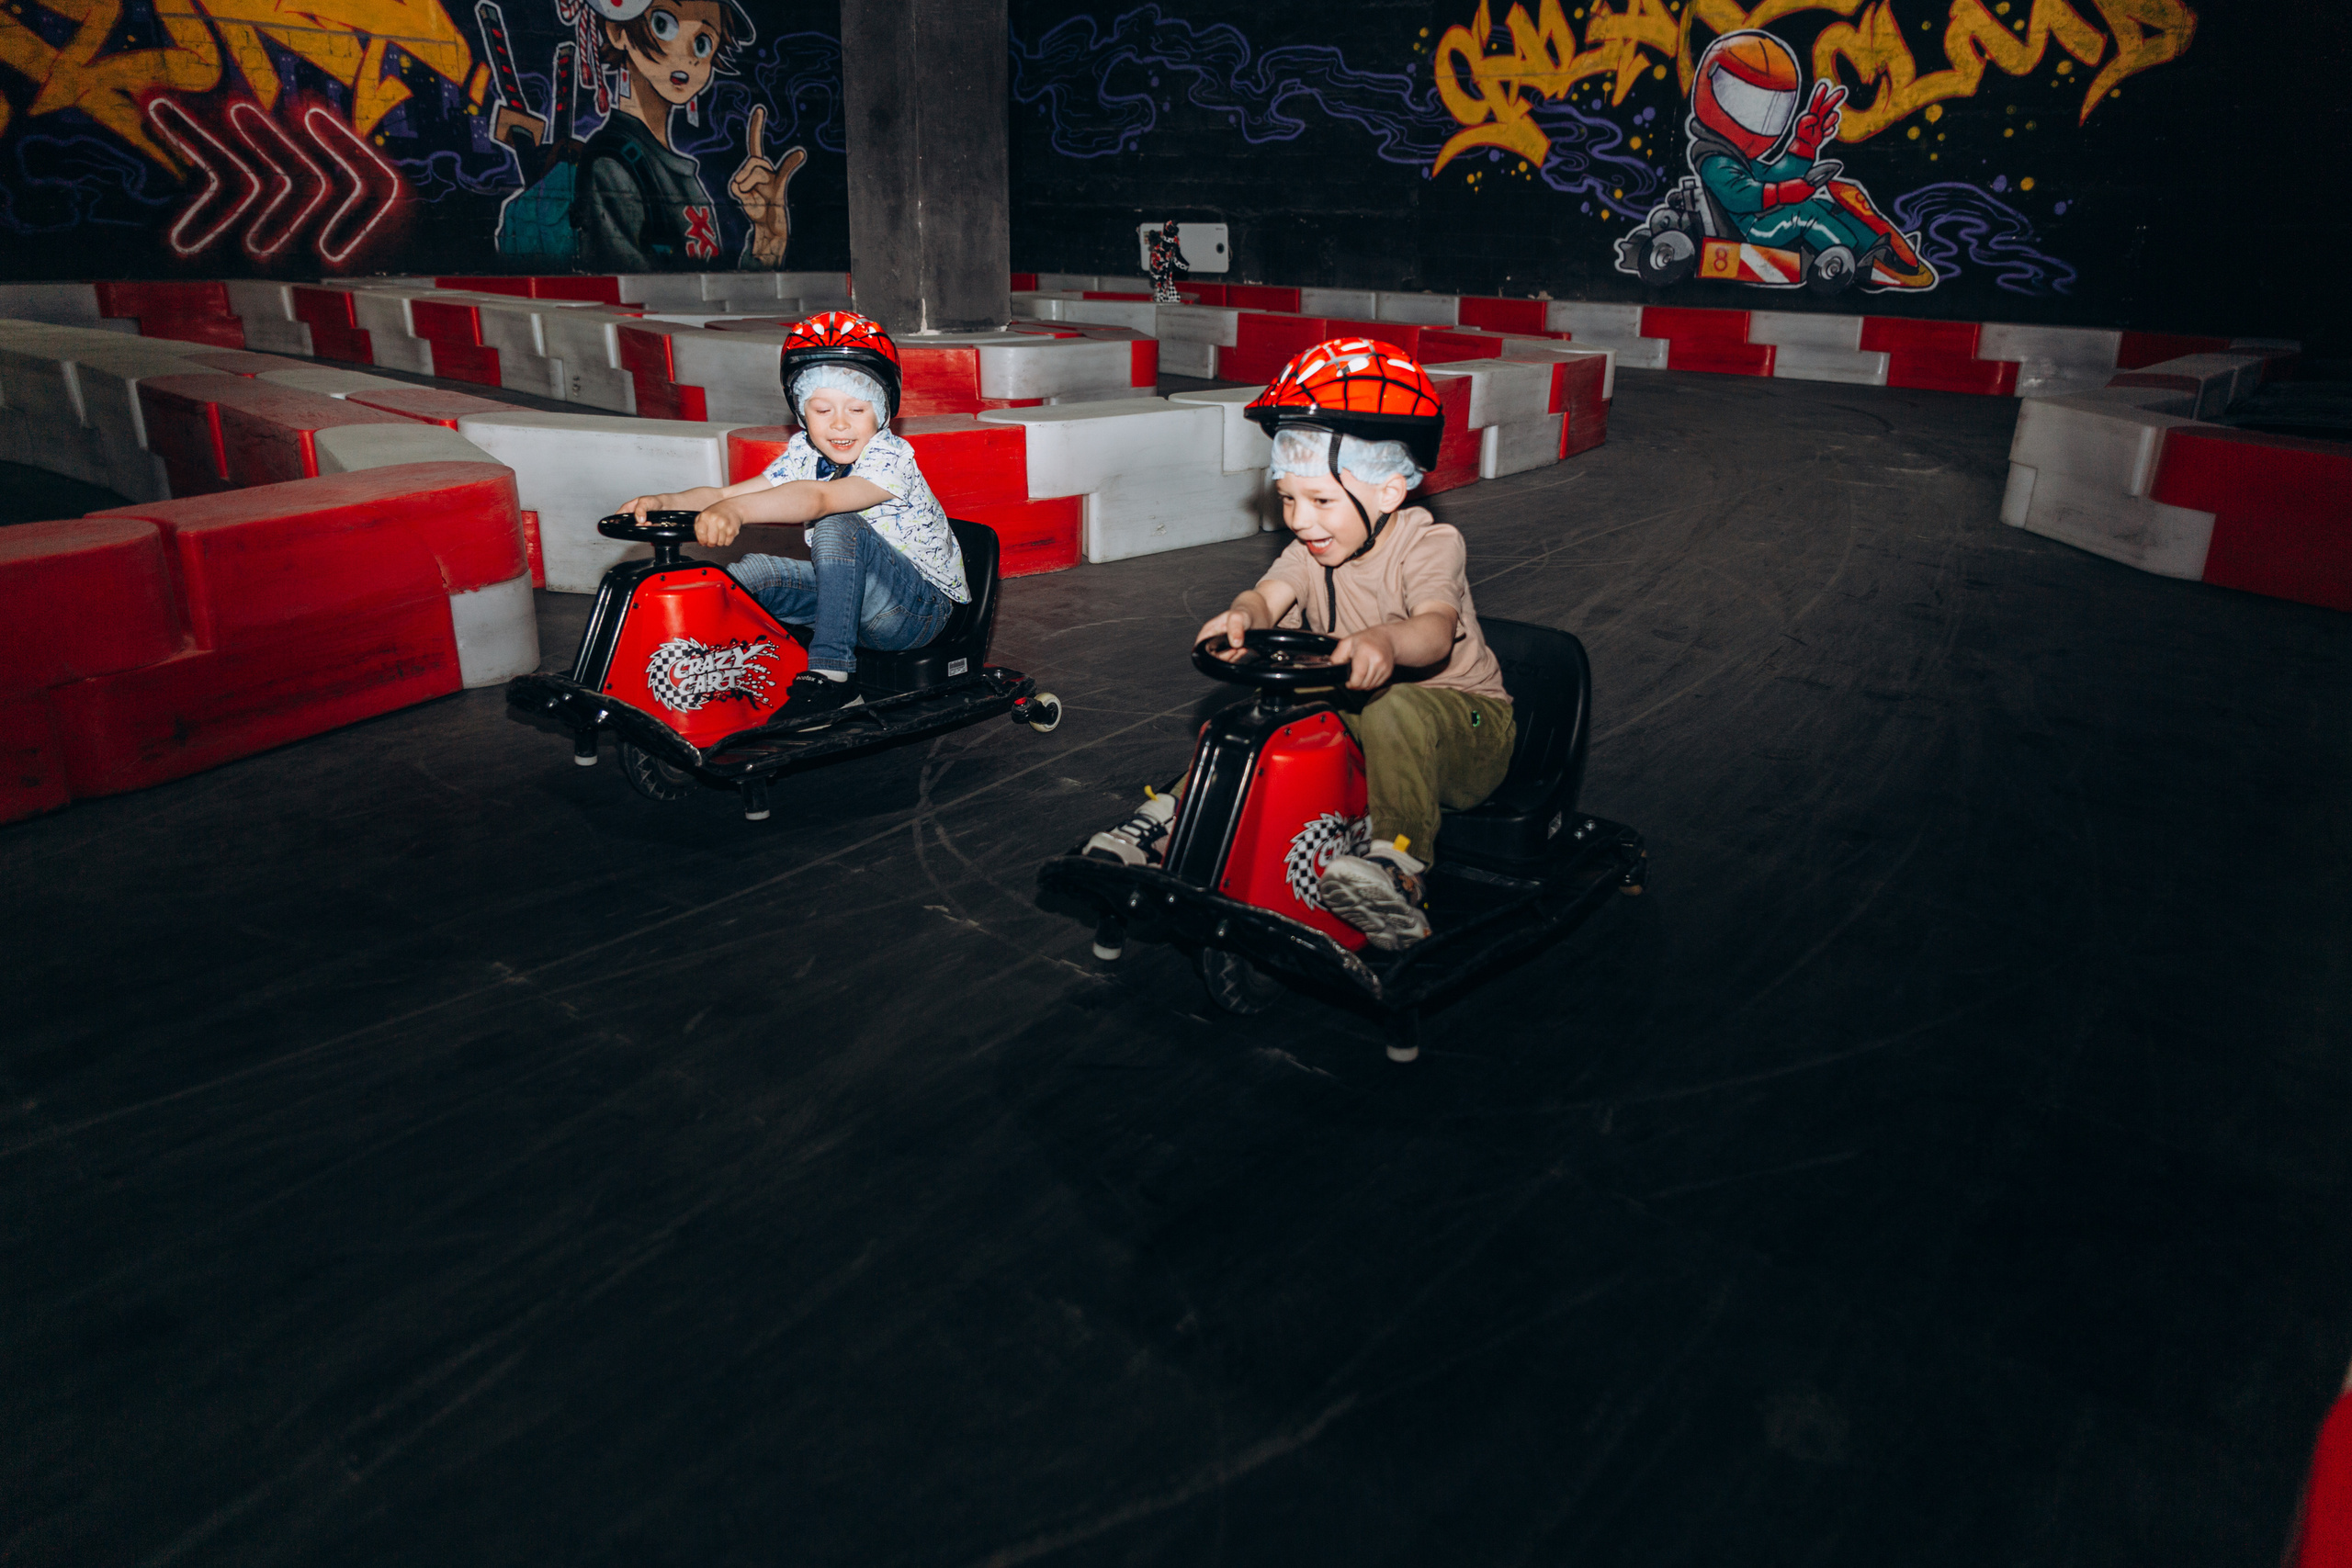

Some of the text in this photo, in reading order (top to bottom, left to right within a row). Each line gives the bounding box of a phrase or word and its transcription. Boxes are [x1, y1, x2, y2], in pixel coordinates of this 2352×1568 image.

[1713, 247, 1728, 272] 8
[674, 643, 770, 679] CRAZY
[677, 669, 744, 695] CART
